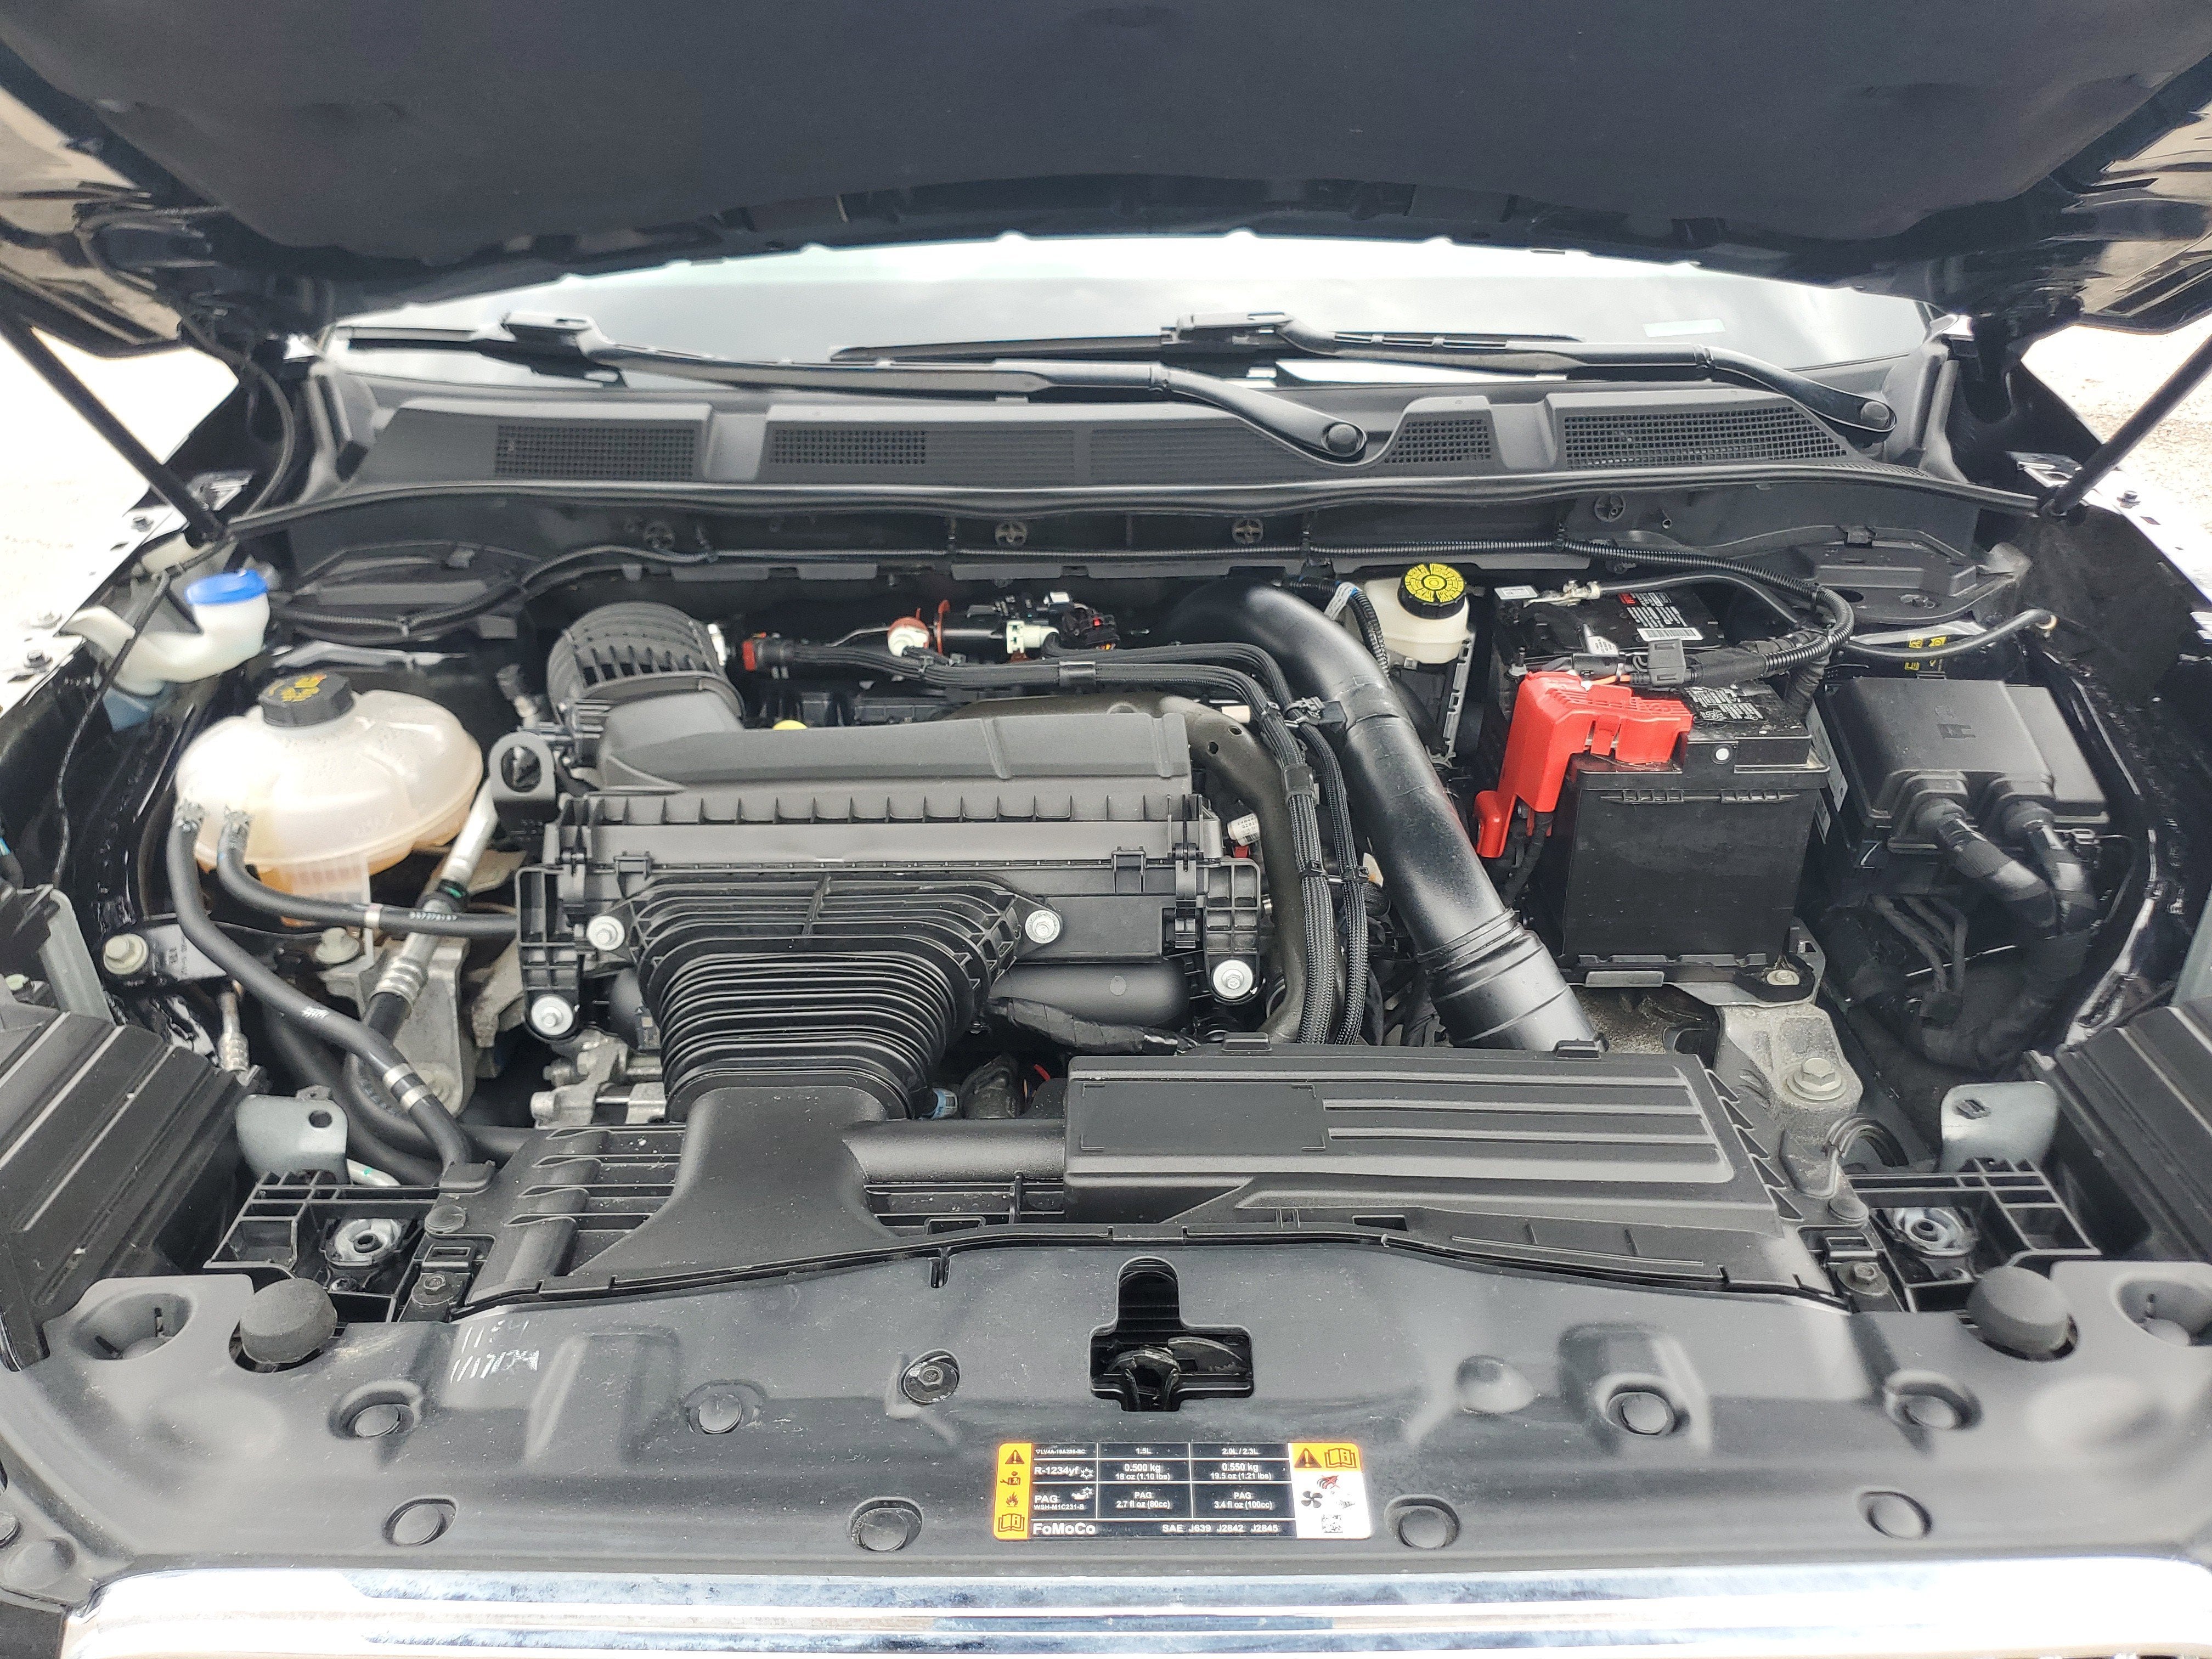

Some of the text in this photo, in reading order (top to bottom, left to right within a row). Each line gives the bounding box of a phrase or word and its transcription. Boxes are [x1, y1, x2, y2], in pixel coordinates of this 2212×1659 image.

[1034, 1466, 1079, 1475] R-1234yf
[1124, 1463, 1161, 1474] 0.500 kg
[1222, 1463, 1259, 1473] 0.550 kg
[1034, 1495, 1058, 1503] PAG
[1147, 1500, 1170, 1509] (80cc)
[1245, 1500, 1272, 1509] (100cc)
[1032, 1522, 1096, 1534] FoMoCo
[1162, 1524, 1278, 1532] SAE J639 J2842 J2845
